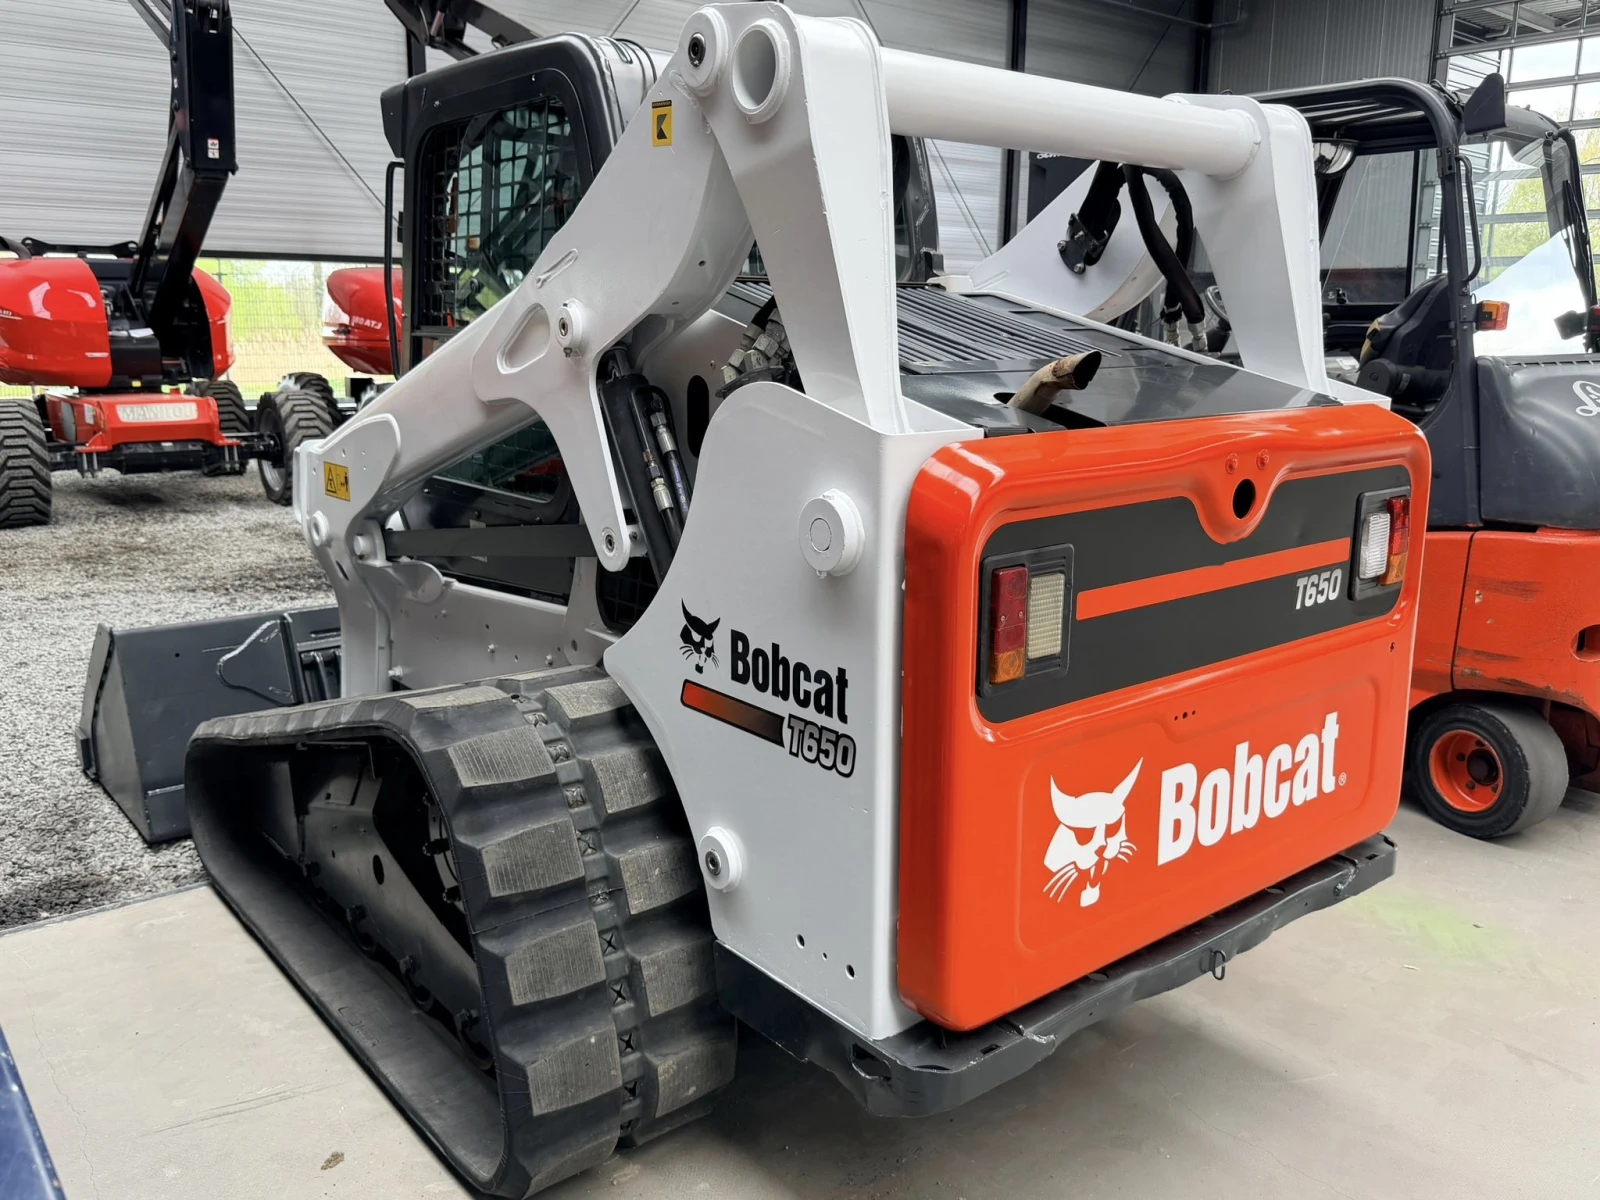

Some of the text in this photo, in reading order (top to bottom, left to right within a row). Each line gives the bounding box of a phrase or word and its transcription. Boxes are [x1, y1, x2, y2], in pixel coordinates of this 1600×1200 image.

[1295, 568, 1342, 610] T650
[730, 628, 849, 725] Bobcat
[787, 712, 857, 779] T650
